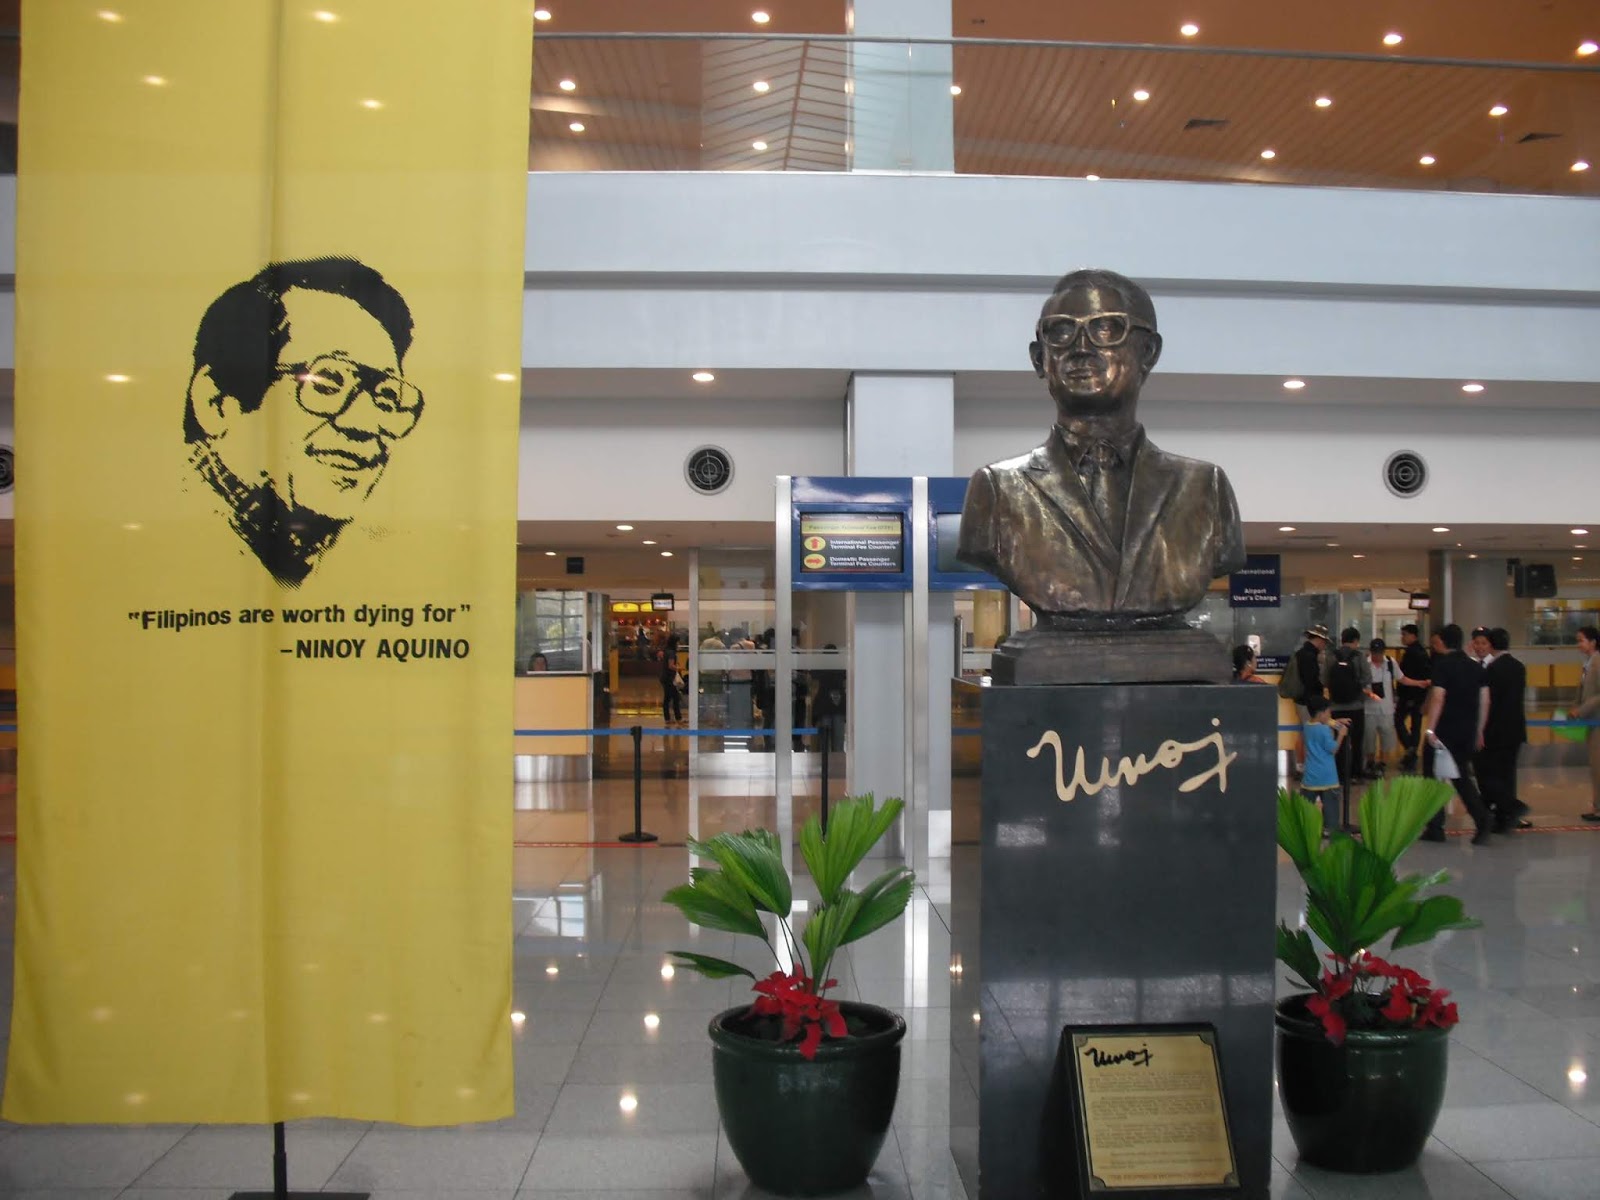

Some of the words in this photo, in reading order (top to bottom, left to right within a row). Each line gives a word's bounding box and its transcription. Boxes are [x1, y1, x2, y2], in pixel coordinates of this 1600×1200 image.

[1244, 587, 1267, 595] Airport
[238, 609, 274, 624] are
[282, 605, 345, 623] worth
[354, 604, 414, 627] dying
[377, 638, 470, 662] AQUINO
